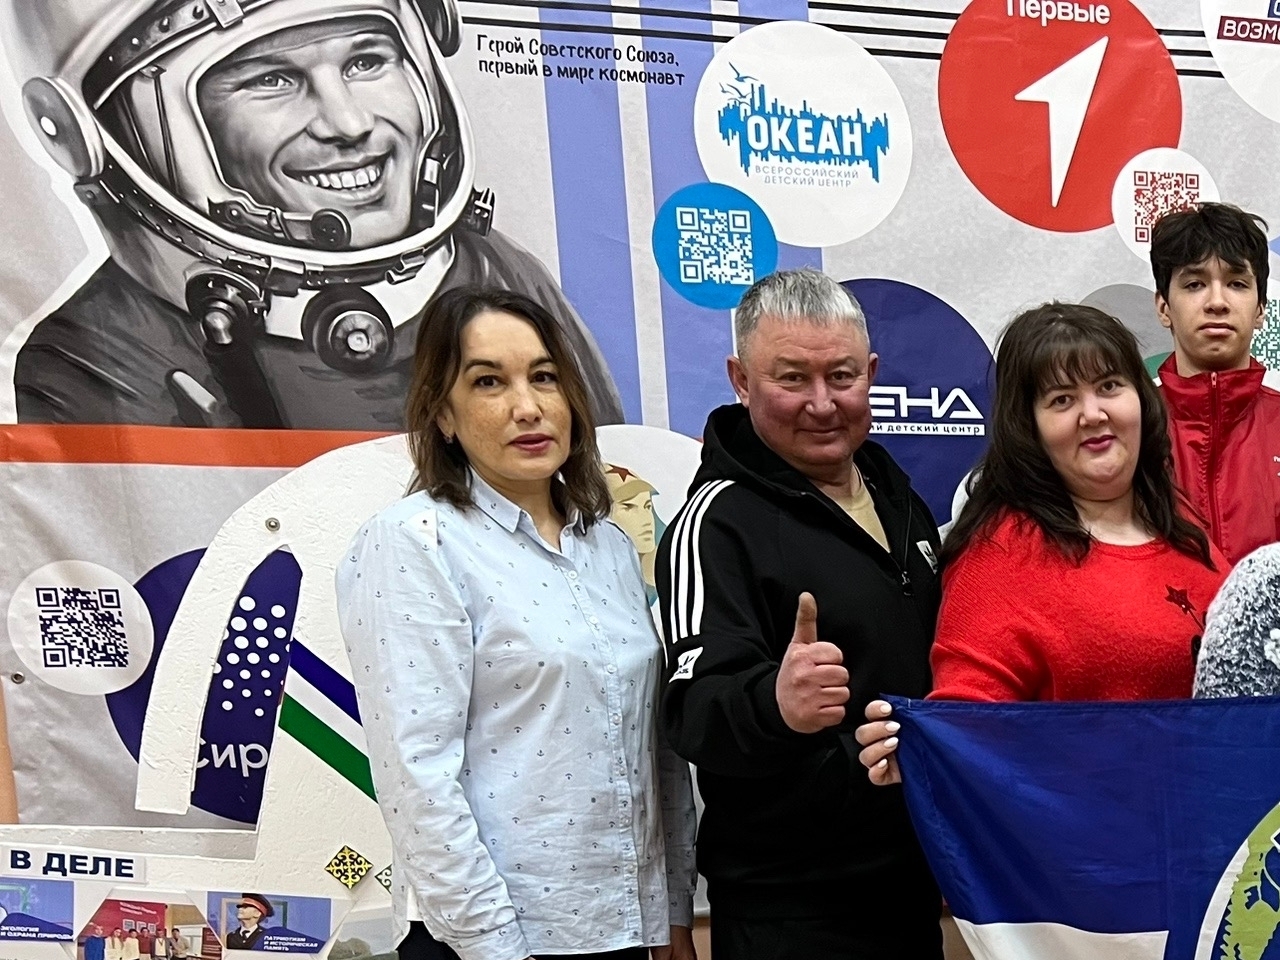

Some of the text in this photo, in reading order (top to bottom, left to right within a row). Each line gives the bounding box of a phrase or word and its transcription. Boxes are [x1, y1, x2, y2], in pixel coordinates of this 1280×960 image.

[477, 34, 679, 66] Герой Советского Союза,
[478, 58, 685, 86] первый в мире космонавт
[747, 115, 863, 156] ОКЕАН
[755, 165, 859, 179] ВСЕРОССИЙСКИЙ
[764, 175, 851, 187] ДЕТСКИЙ ЦЕНТР
[868, 386, 984, 419] ЕНА
[887, 423, 939, 433] детский
[943, 425, 980, 435] центр
[10, 849, 134, 878] В ДЕЛЕ
